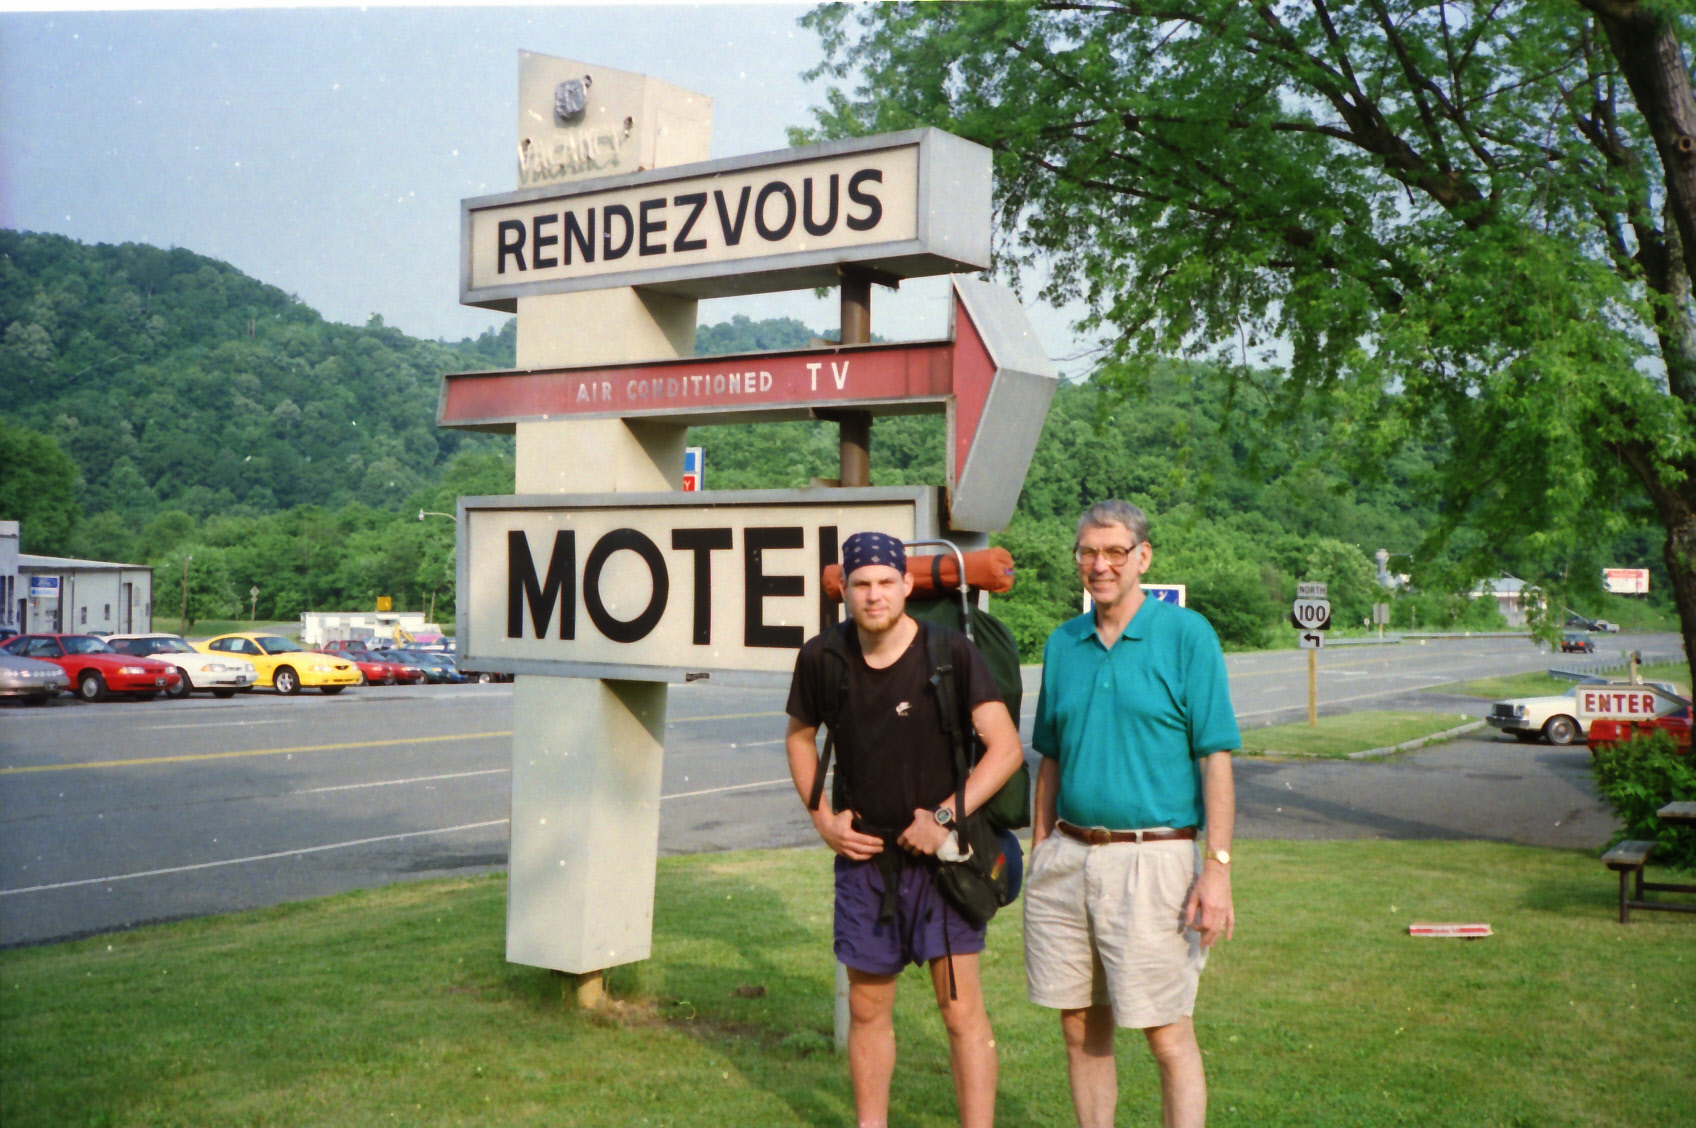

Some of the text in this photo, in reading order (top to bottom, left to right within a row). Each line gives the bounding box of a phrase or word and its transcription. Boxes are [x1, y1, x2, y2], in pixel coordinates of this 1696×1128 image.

[497, 168, 884, 275] RENDEZVOUS
[576, 361, 850, 403] AIR CONDITIONED TV
[1299, 585, 1326, 595] NORTH
[1299, 604, 1326, 622] 100
[1585, 693, 1655, 713] ENTER
